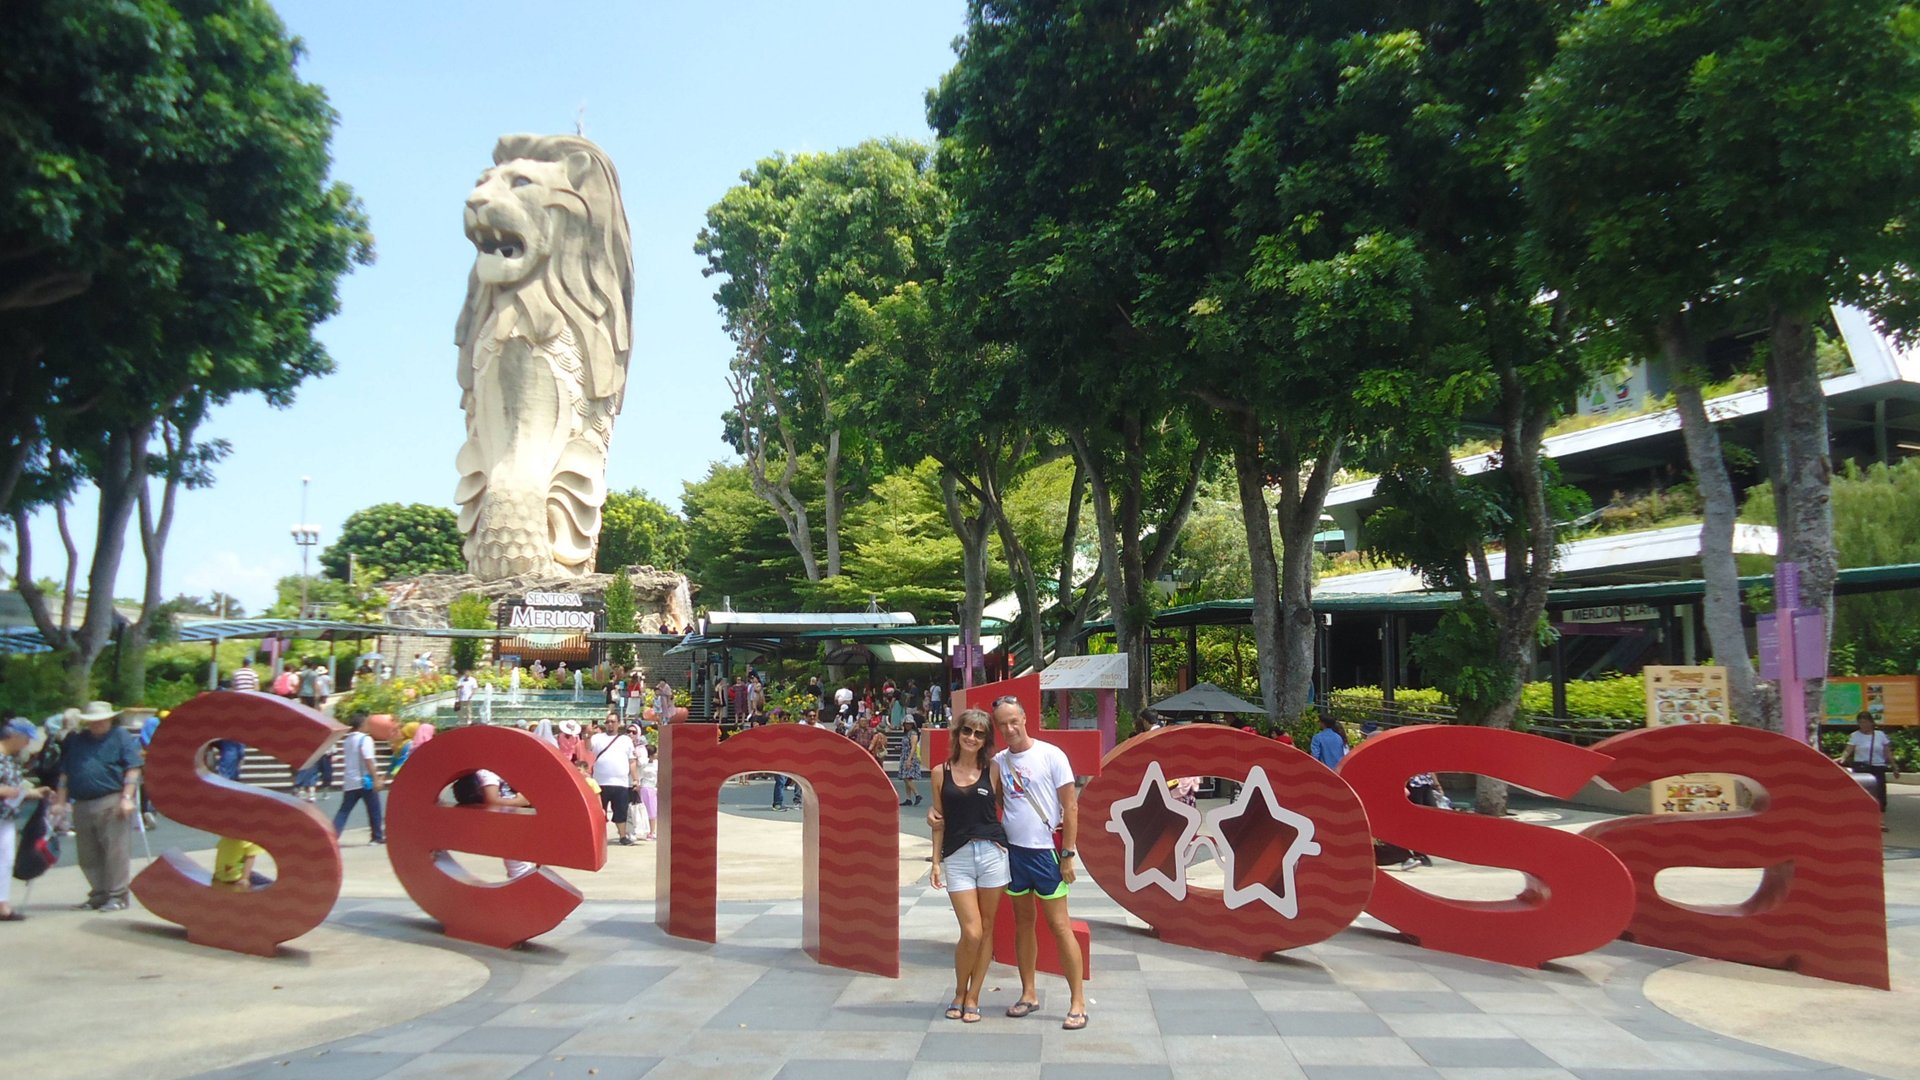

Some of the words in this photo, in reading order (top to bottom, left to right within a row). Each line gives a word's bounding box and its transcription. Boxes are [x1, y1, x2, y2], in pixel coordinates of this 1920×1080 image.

[527, 592, 581, 605] SENTOSA
[513, 607, 593, 627] MERLION
[1571, 606, 1621, 620] MERLION
[131, 672, 1890, 989] sentosa
